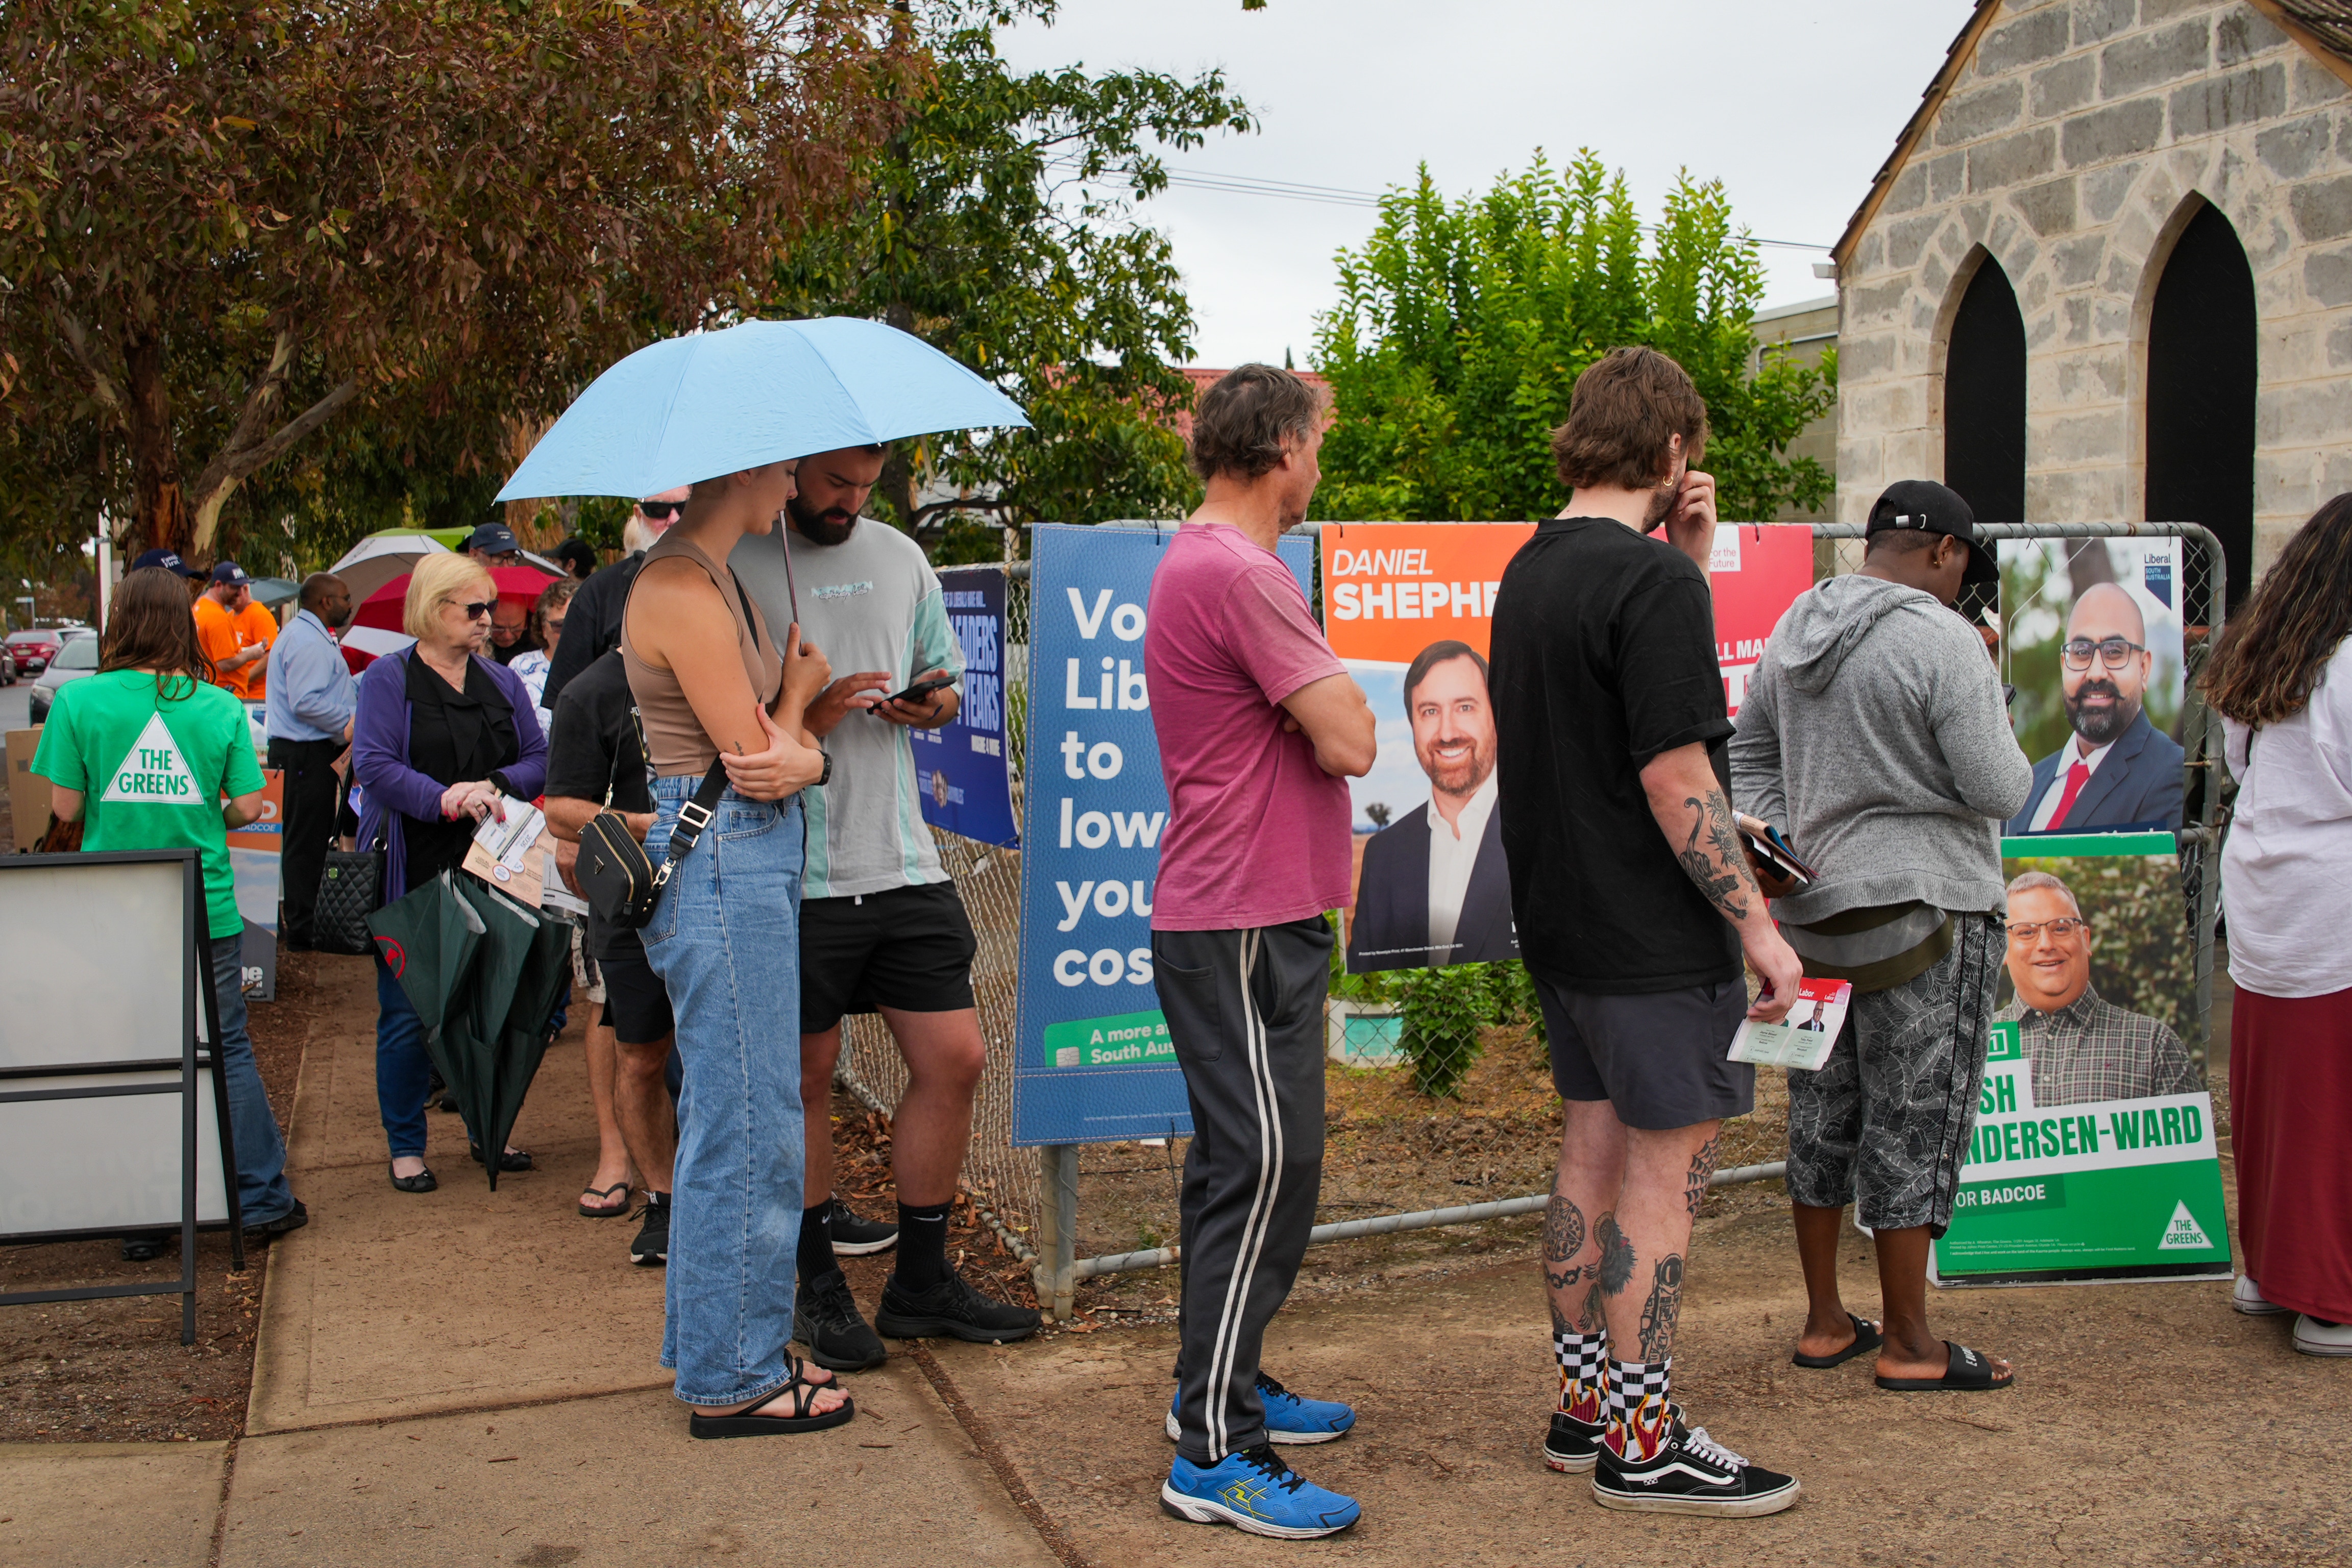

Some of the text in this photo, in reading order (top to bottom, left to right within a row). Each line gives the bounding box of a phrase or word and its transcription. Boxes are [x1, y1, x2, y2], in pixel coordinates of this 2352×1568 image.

[1332, 549, 1433, 576] DANIEL
[1709, 558, 1734, 568] Future
[1723, 547, 1736, 557] the
[2144, 553, 2171, 564] Liberal
[1067, 588, 1146, 641] Vo
[1066, 656, 1150, 711] Lib
[964, 673, 1000, 732] YEARS
[139, 749, 173, 770] THE
[1061, 731, 1123, 780] to
[118, 773, 189, 796] GREENS
[1060, 798, 1170, 848] low
[1056, 880, 1154, 932] you
[1053, 948, 1154, 987] cos
[1798, 988, 1815, 997] Labor
[1090, 1029, 1104, 1045] A
[1108, 1025, 1152, 1042] more
[1091, 1041, 1175, 1064] South Aus
[1979, 1074, 2016, 1115] SH
[1955, 1184, 2046, 1208] OR BADCOE
[2174, 1219, 2192, 1231] THE
[2166, 1232, 2202, 1244] GREENS
